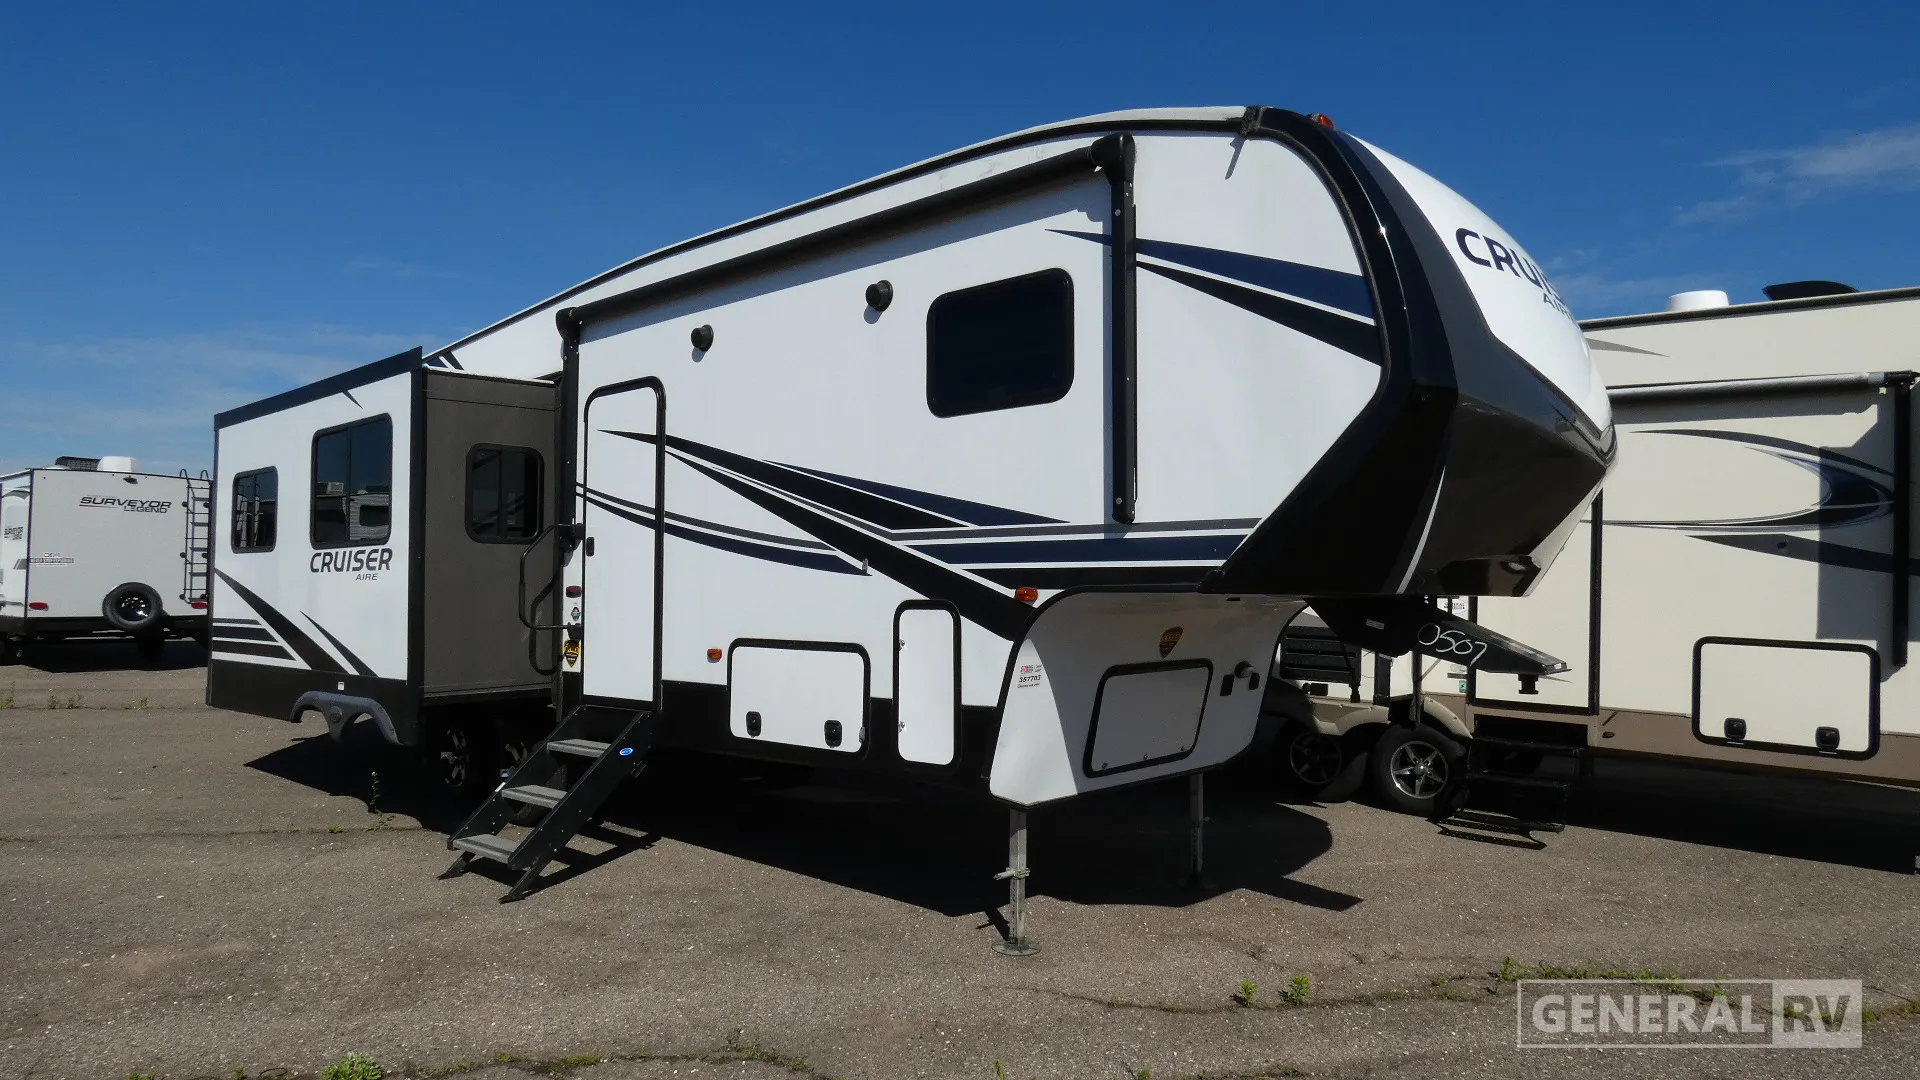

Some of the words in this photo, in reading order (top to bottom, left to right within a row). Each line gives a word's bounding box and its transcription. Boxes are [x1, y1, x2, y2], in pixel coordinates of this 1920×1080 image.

[1455, 227, 1565, 306] CRUI
[80, 496, 172, 509] SURVEYOR
[123, 505, 168, 514] LEGEND
[309, 547, 393, 573] CRUISER
[355, 572, 379, 581] AIRE
[1417, 622, 1488, 667] 0507
